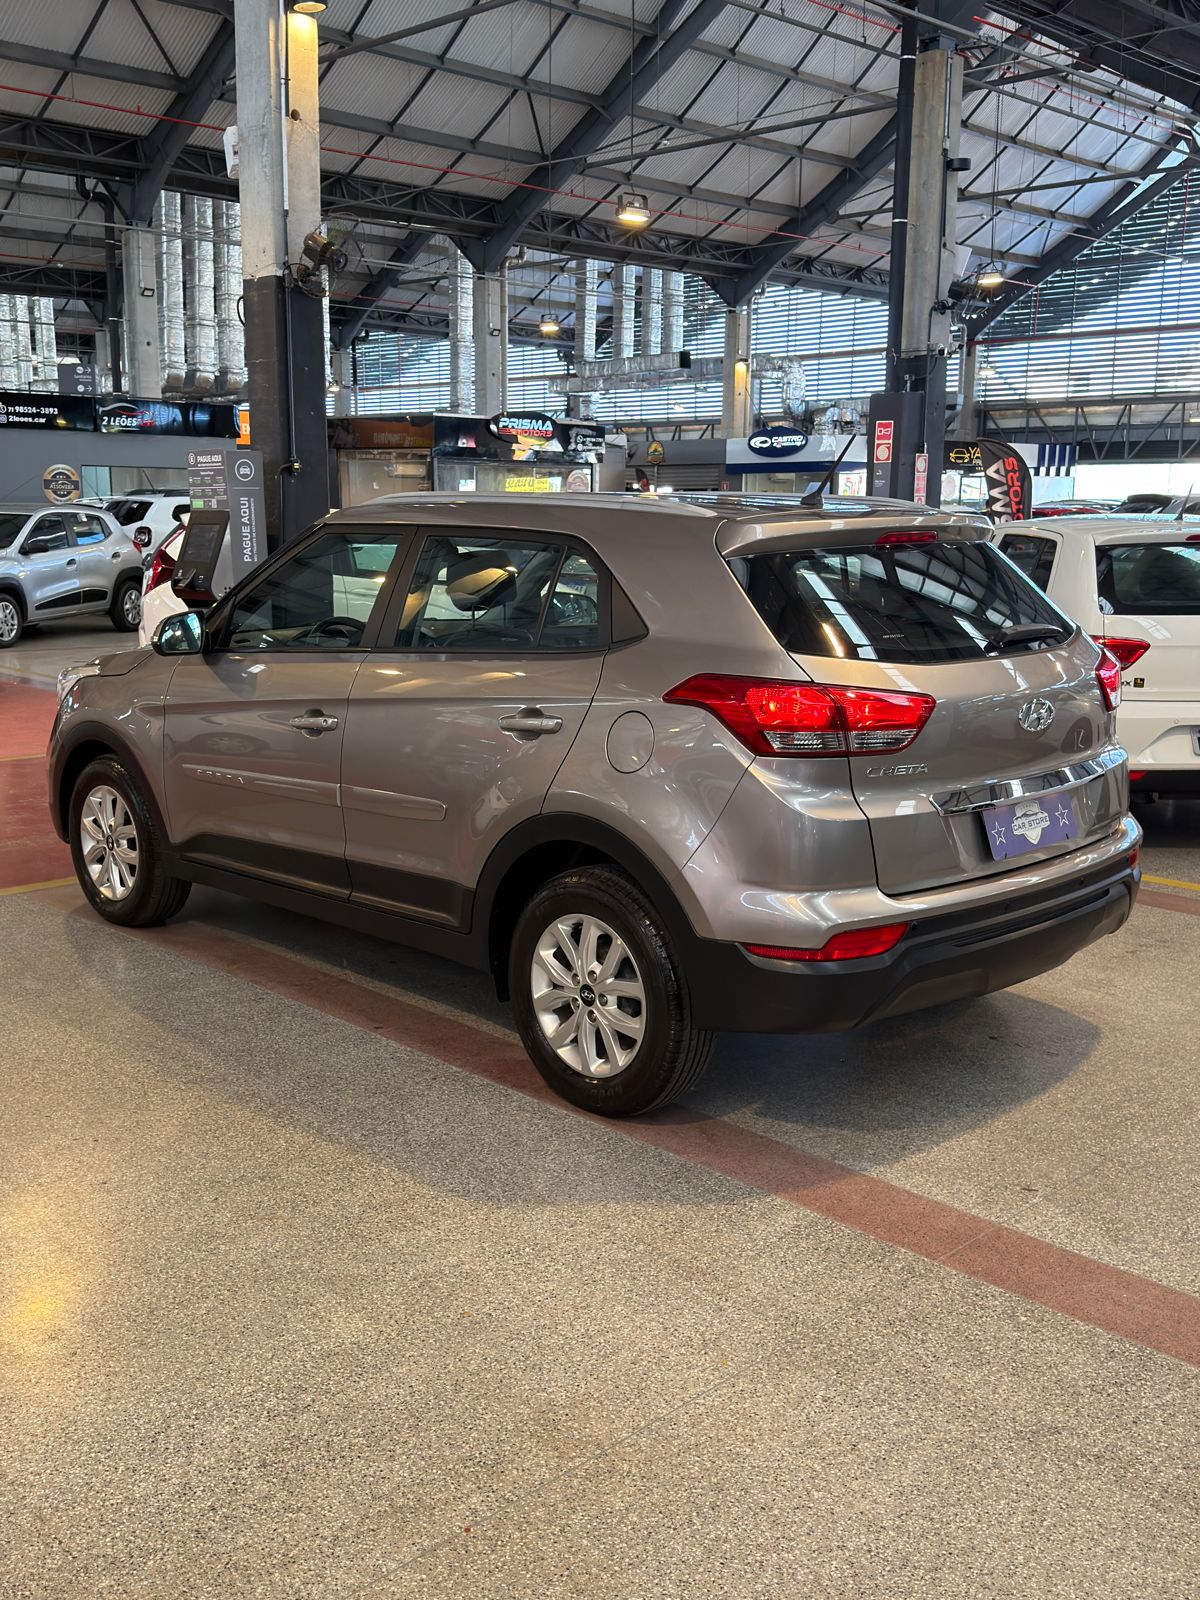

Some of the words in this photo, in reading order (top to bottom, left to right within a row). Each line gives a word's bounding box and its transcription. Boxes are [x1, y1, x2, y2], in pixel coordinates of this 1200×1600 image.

[102, 416, 108, 425] 2
[110, 415, 137, 426] LEÕES
[499, 417, 553, 431] PRISMA
[772, 435, 804, 443] CASTRO
[196, 455, 211, 463] PAGUE
[212, 454, 222, 462] AQUI
[968, 446, 982, 459] YA
[240, 497, 250, 524] AQUI
[242, 525, 252, 562] PAGUE
[866, 763, 929, 778] CRETA
[1012, 822, 1026, 832] CAR
[1028, 815, 1049, 828] STORE
